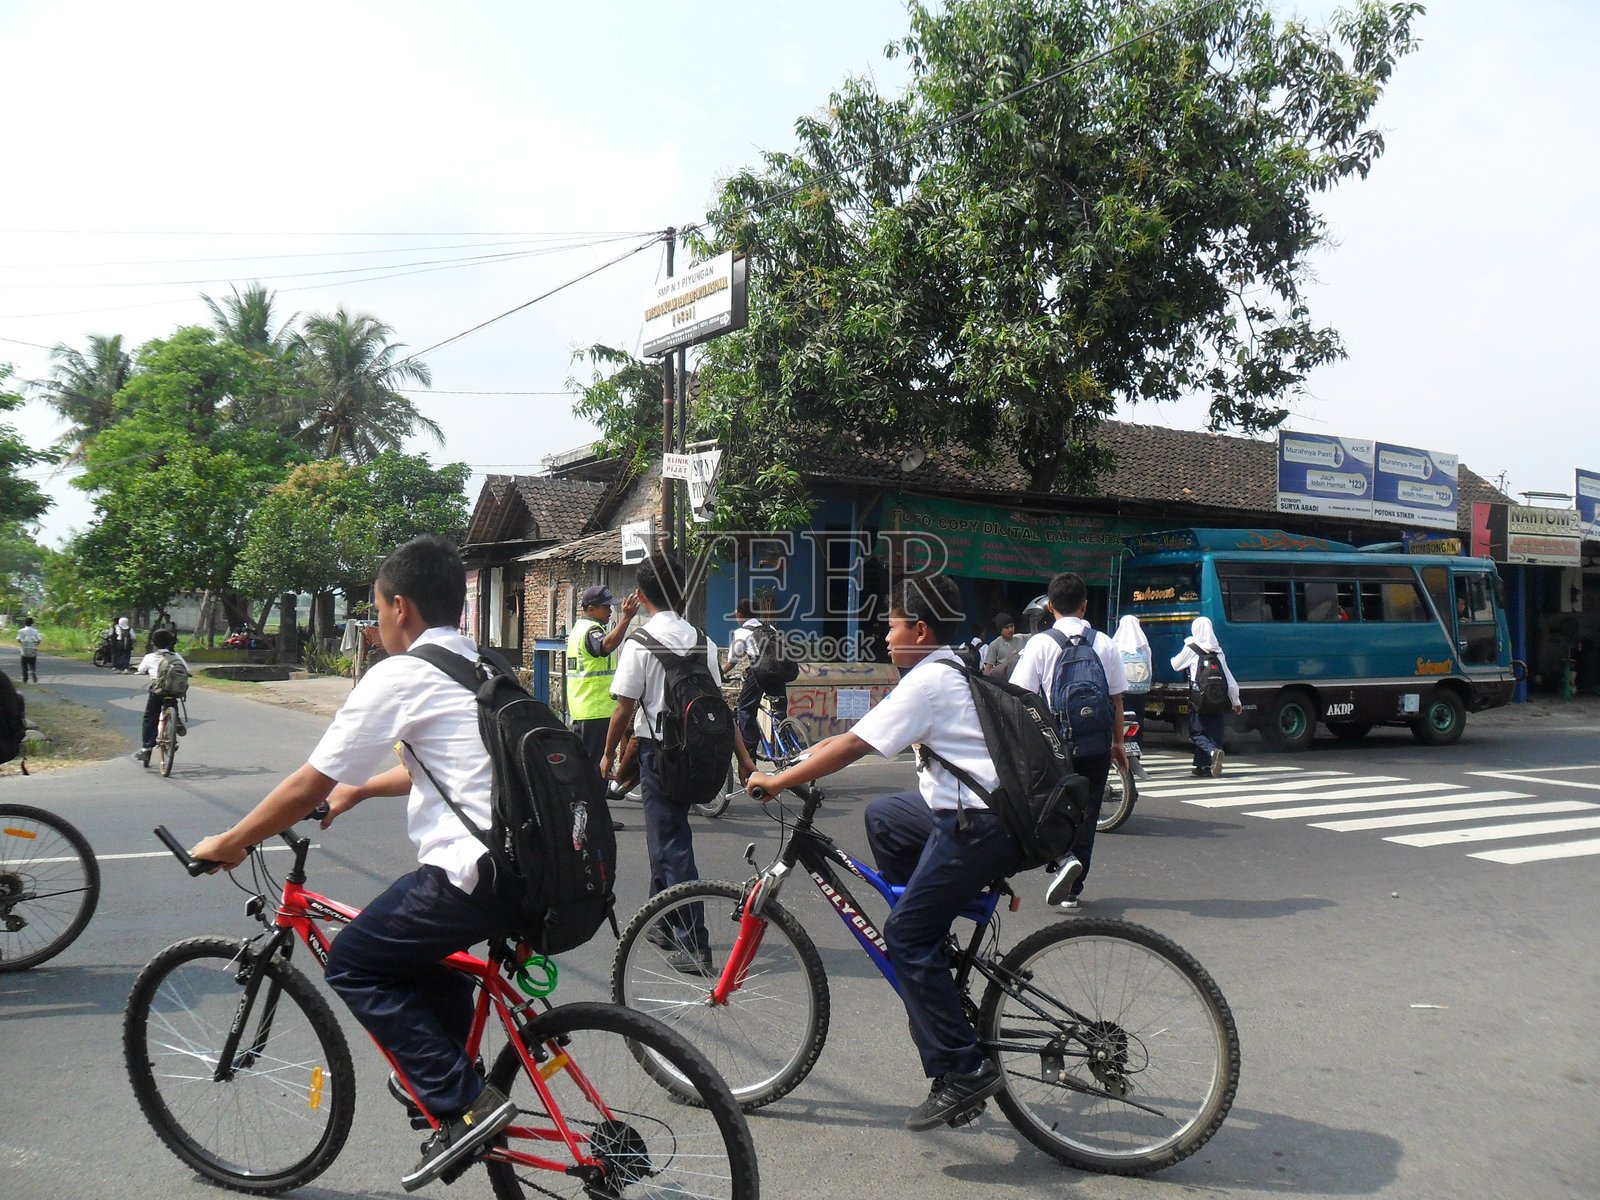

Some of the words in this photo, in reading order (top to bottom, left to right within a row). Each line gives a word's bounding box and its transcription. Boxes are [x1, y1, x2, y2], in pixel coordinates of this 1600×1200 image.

[1280, 502, 1300, 511] SURYA
[1301, 504, 1319, 512] ABADI
[1396, 511, 1415, 520] STIKER
[938, 516, 980, 534] COPY
[983, 521, 1041, 541] DIGITAL
[1326, 703, 1355, 716] AKDP
